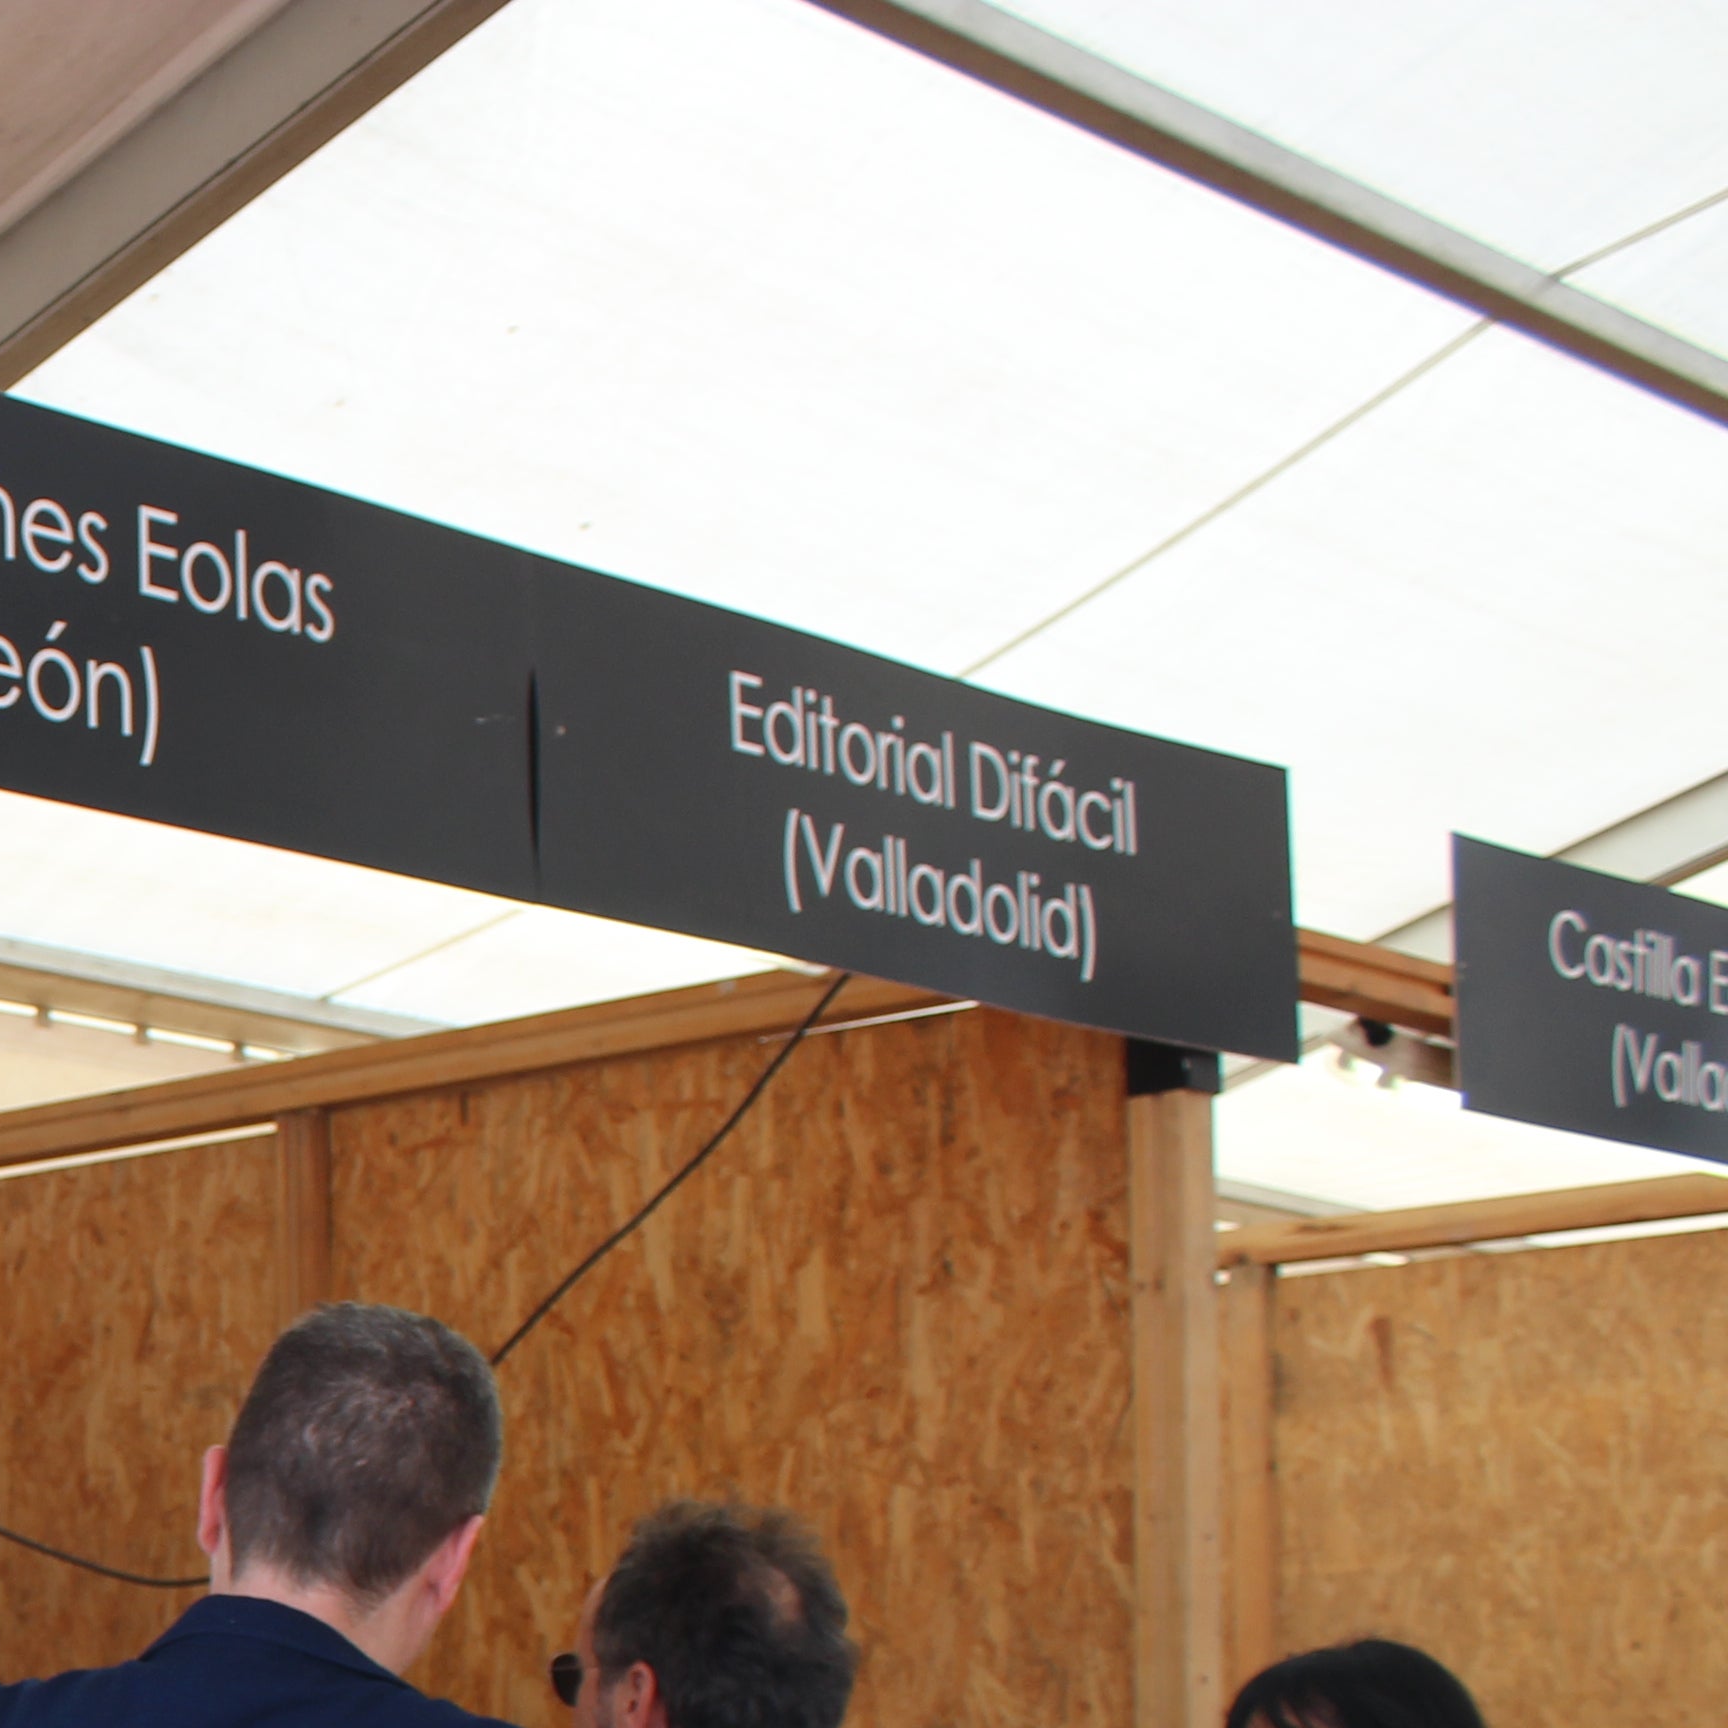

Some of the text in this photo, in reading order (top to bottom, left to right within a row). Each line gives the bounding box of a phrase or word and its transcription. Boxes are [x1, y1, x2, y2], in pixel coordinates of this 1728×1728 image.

[137, 504, 337, 644] Eolas
[729, 669, 1138, 857] Editorial Difácil
[784, 808, 1098, 983] (Valladolid)
[1548, 909, 1702, 1007] Castilla
[1611, 1023, 1728, 1112] (Valla
